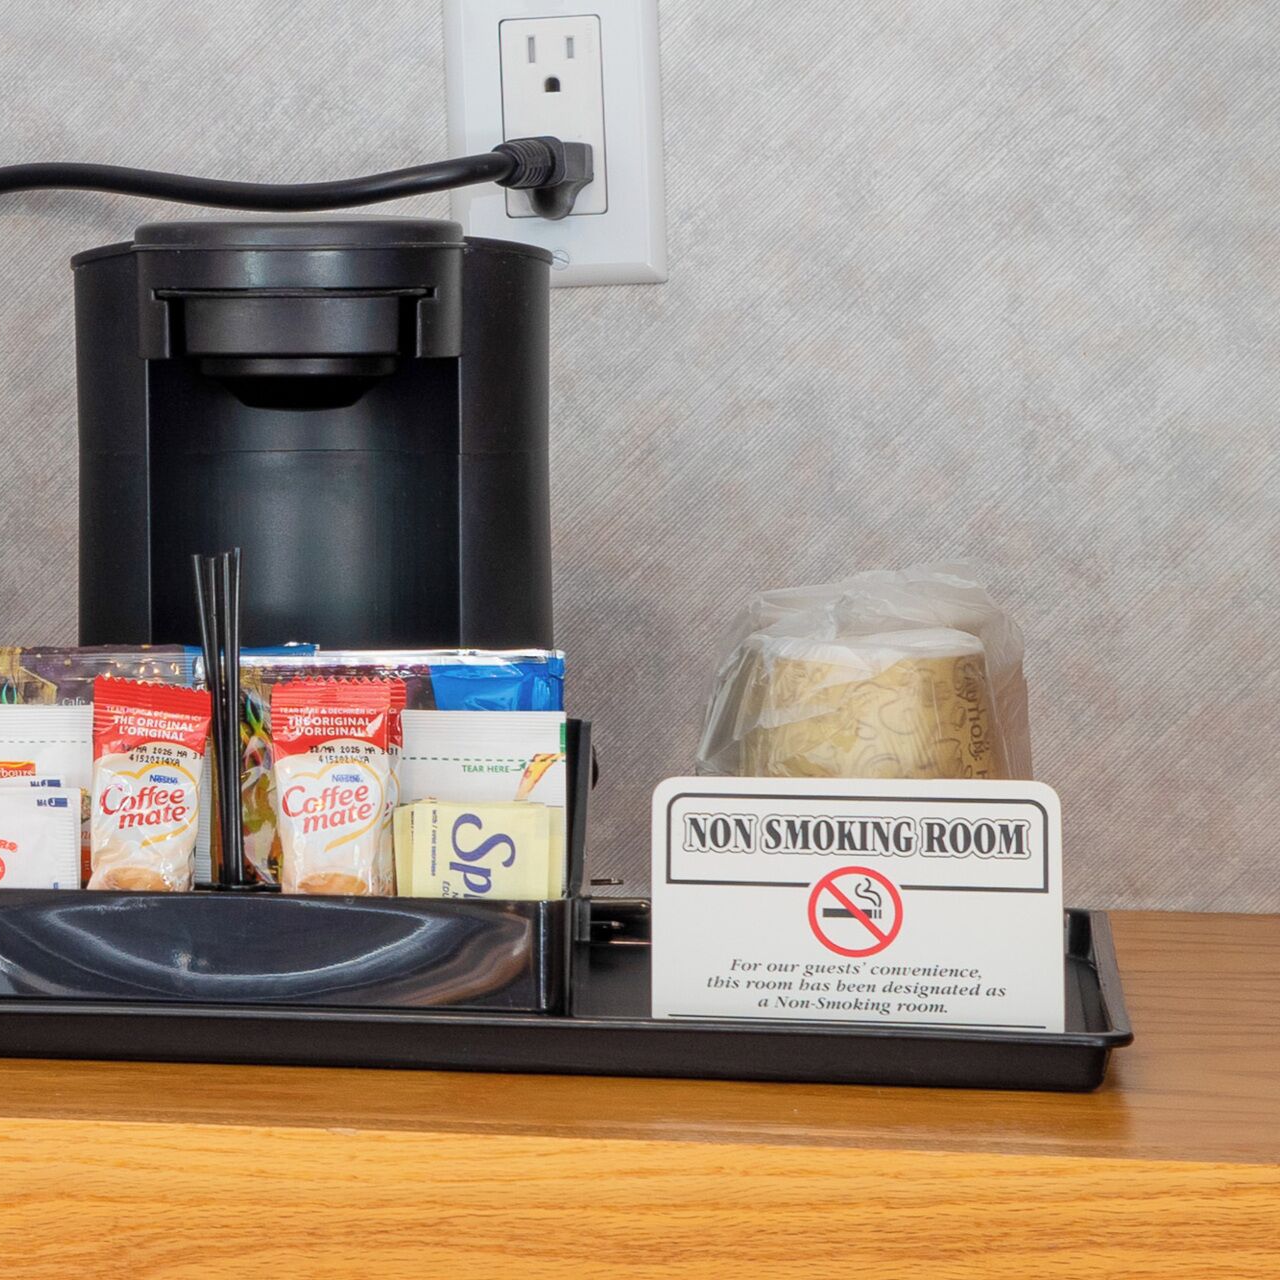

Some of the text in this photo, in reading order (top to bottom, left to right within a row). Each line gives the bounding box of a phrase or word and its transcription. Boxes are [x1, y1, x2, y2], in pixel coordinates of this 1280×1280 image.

[113, 715, 195, 732] THE ORIGINAL
[312, 716, 371, 726] ORIGINAL
[118, 725, 185, 741] L'ORIGINAL
[340, 745, 360, 754] 2026
[461, 764, 510, 773] TEAR HERE
[100, 783, 185, 815] Coffee
[282, 785, 369, 817] Coffee
[118, 805, 186, 830] mate
[303, 803, 372, 833] mate
[687, 816, 1027, 856] NON SMOKING ROOM
[449, 813, 516, 898] Sp
[730, 958, 762, 972] For
[766, 961, 800, 973] our
[870, 964, 983, 980] convenience,
[706, 975, 1008, 999] this room has been designated as
[757, 995, 949, 1016] a Non-Smoking room.
